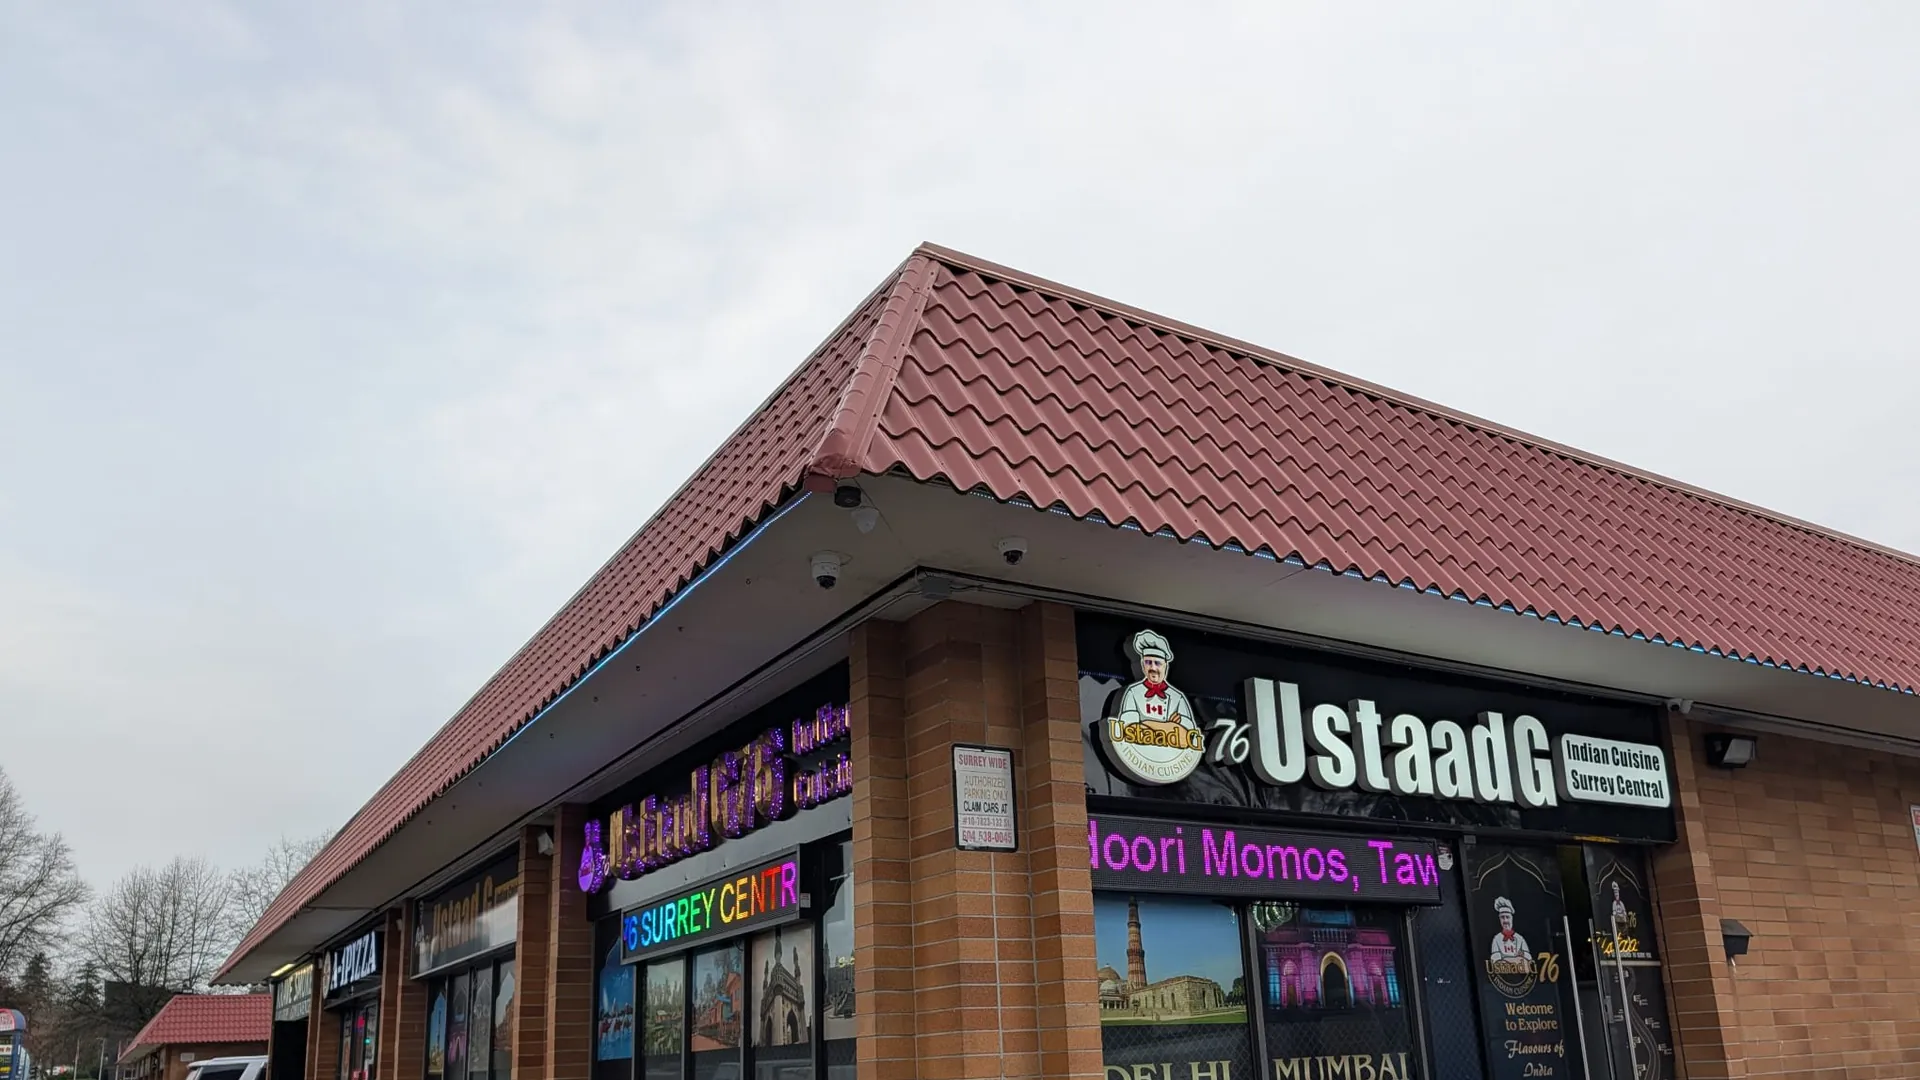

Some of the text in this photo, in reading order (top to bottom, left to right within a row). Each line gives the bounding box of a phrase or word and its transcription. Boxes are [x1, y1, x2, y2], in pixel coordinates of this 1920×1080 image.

[1109, 719, 1204, 752] Ustaad G
[1213, 718, 1252, 764] 76
[958, 753, 1007, 770] SURREY WIDE
[1122, 746, 1193, 777] INDIAN CUISINE
[1565, 739, 1660, 772] Indian Cuisine
[963, 786, 991, 800] PARKING
[964, 775, 1006, 789] AUTHORIZED
[1571, 768, 1665, 800] Surrey Central
[963, 800, 1008, 815] CLAIM CARS AT
[1202, 828, 1359, 892] Momos,
[641, 888, 716, 947] SURREY
[719, 861, 797, 924] CENTR
[1538, 952, 1559, 983] 76
[1505, 1002, 1554, 1016] Welcome
[1505, 1018, 1558, 1033] to Explore
[1504, 1039, 1565, 1059] Flavours of
[1523, 1062, 1553, 1078] India
